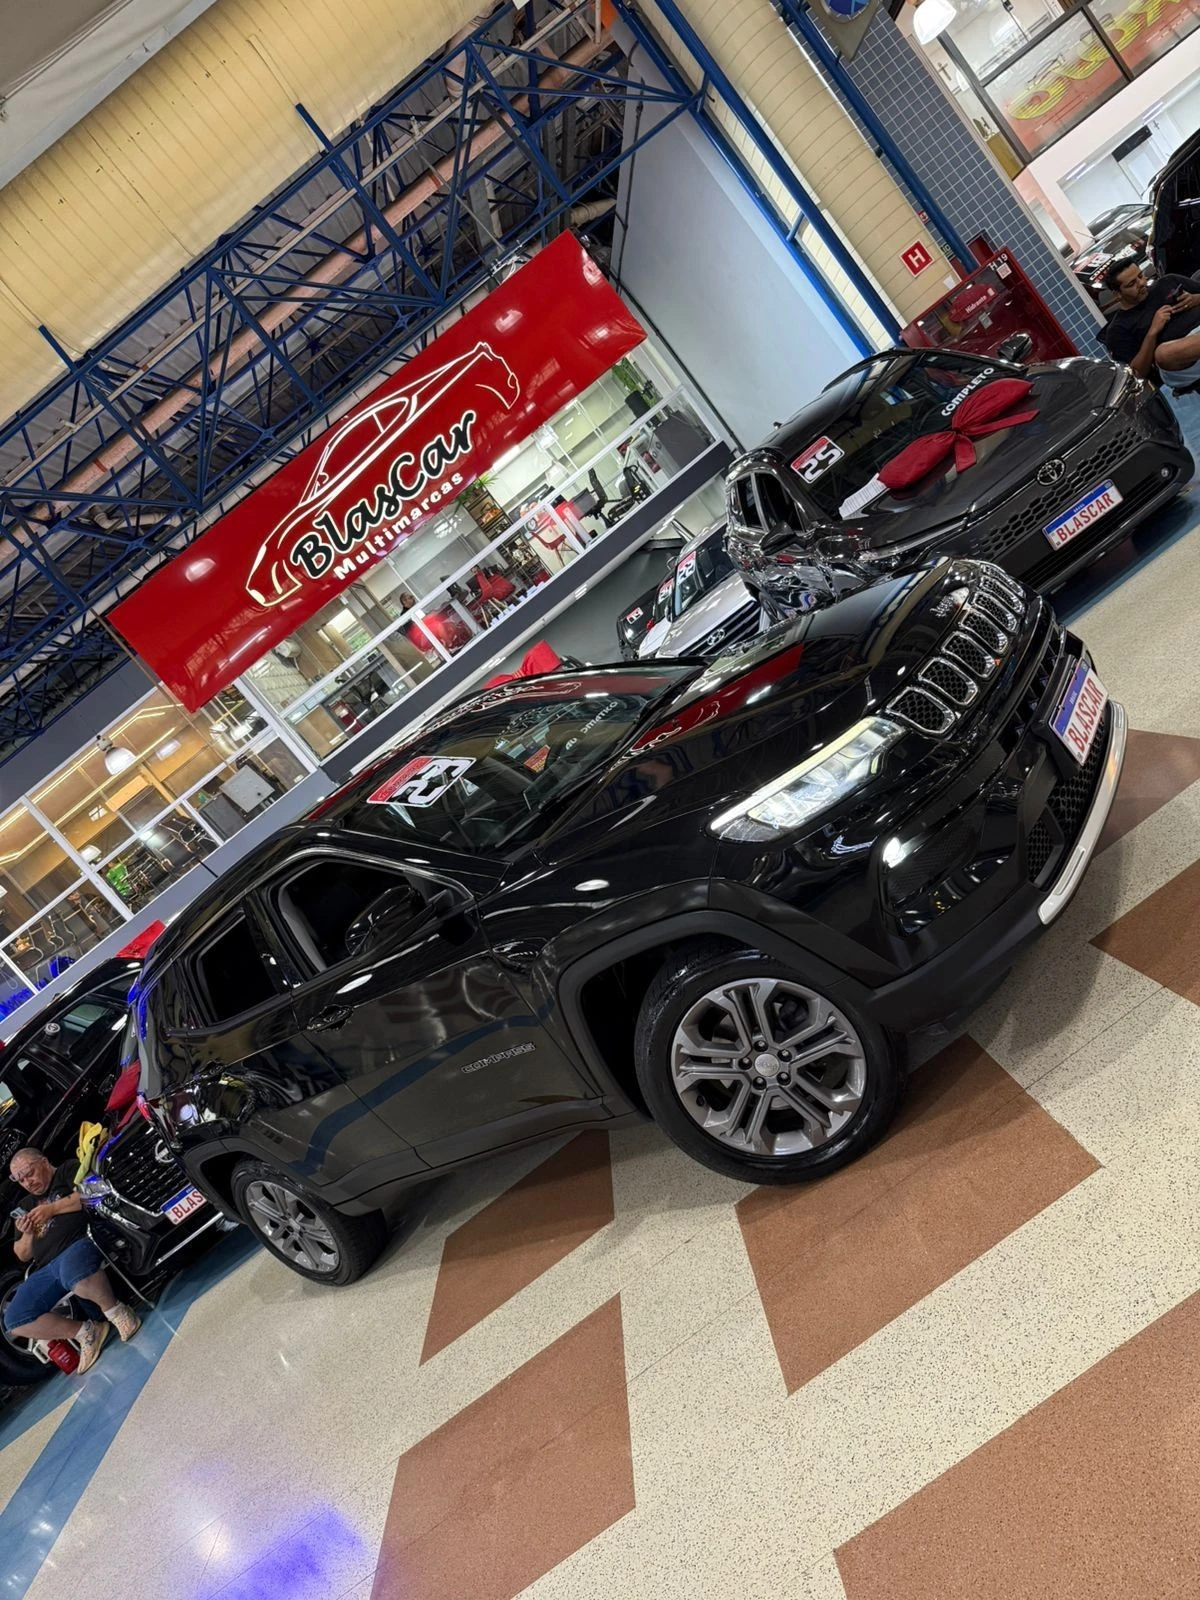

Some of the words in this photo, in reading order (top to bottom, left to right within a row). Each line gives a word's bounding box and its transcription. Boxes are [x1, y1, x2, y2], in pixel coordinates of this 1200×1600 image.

[907, 248, 926, 269] H
[988, 261, 998, 271] H
[997, 253, 1009, 264] 19
[964, 295, 988, 314] Hidrante
[940, 367, 995, 417] COMPLETO
[801, 443, 843, 482] 25
[289, 409, 477, 580] BlasCar
[1055, 492, 1115, 542] BLASCAR
[332, 471, 465, 581] Multimarcas
[1067, 677, 1104, 753] BLASCAR
[391, 757, 472, 805] 23
